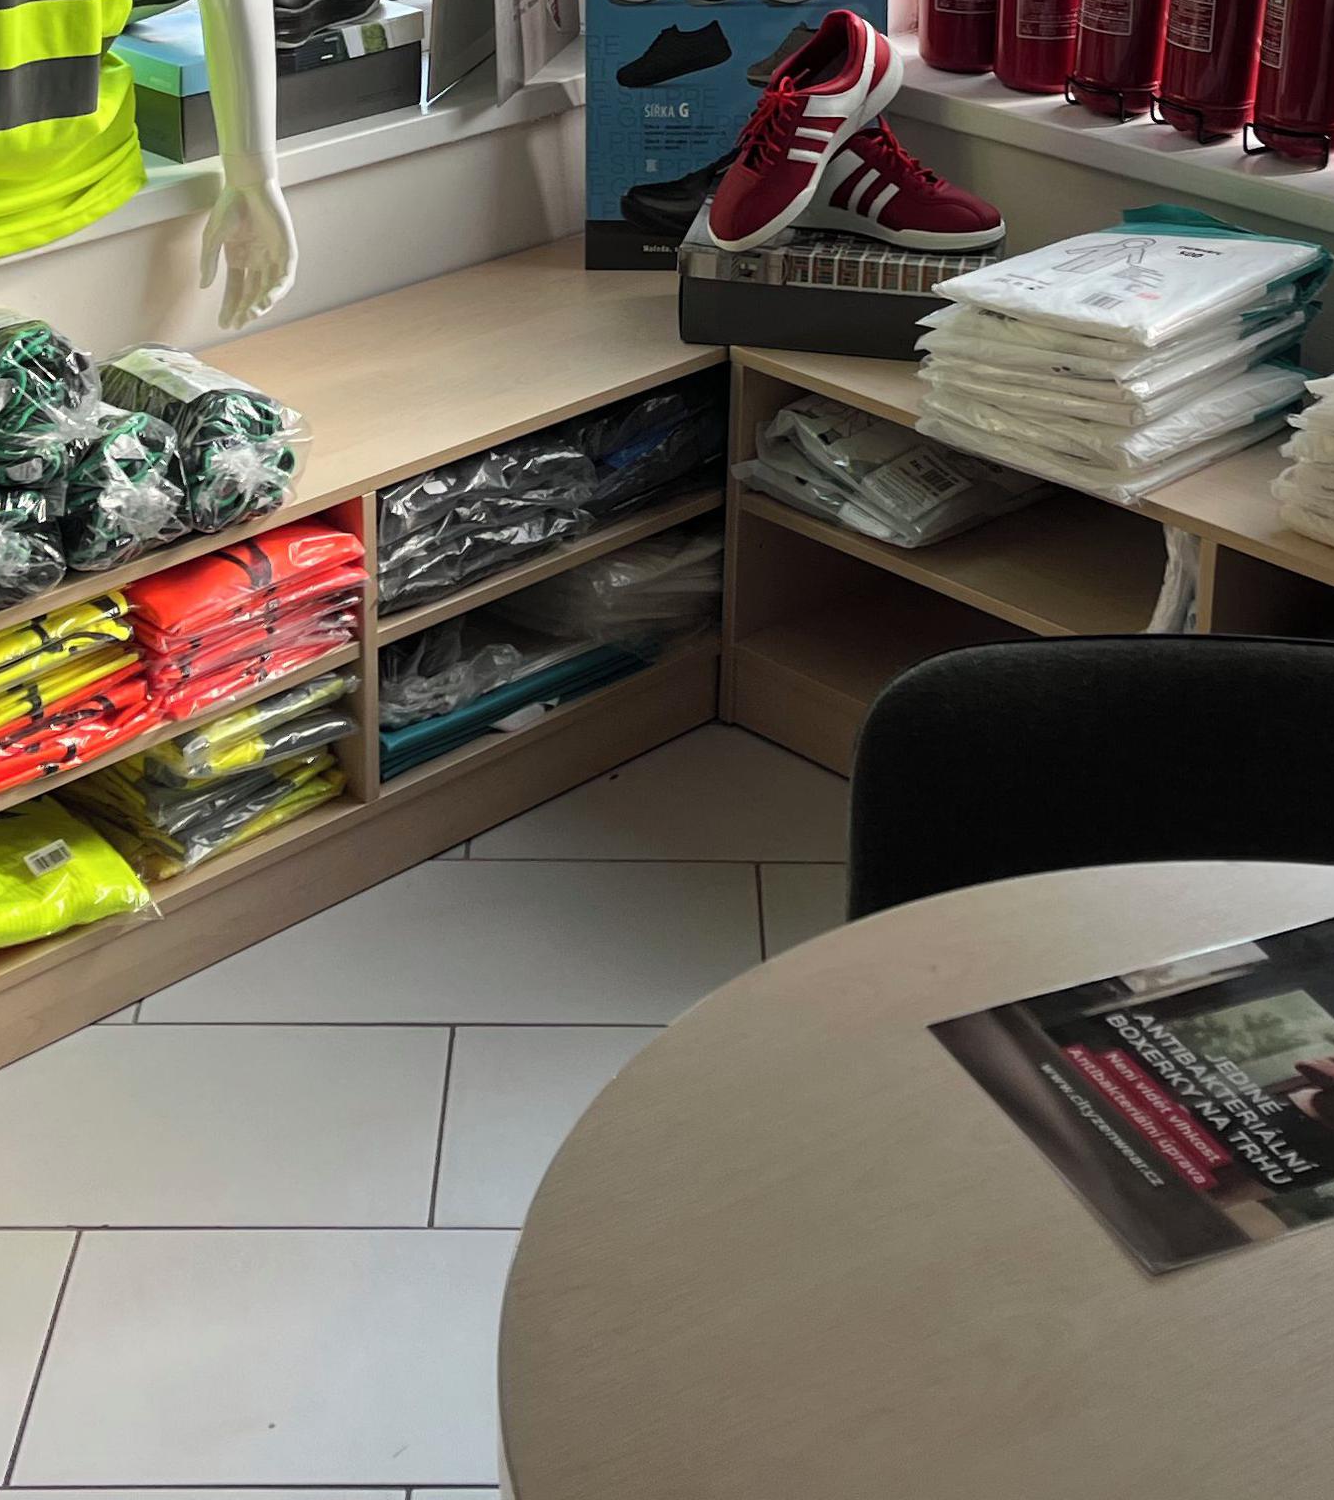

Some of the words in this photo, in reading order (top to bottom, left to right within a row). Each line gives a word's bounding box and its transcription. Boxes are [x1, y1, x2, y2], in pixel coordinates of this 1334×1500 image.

[644, 102, 676, 119] ŠÍŘKA
[678, 101, 690, 118] G
[1105, 1013, 1204, 1098] BOXERKY
[1195, 1101, 1232, 1132] NA
[1227, 1130, 1294, 1186] TRHU
[1134, 1012, 1320, 1174] ANTIBAKTERIÁLNÍ
[1205, 1053, 1289, 1116] JEDINÉ
[1040, 1062, 1166, 1188] www.cityzenwear.cz
[1168, 1113, 1222, 1164] vlhkost
[1157, 1136, 1208, 1185] úprava
